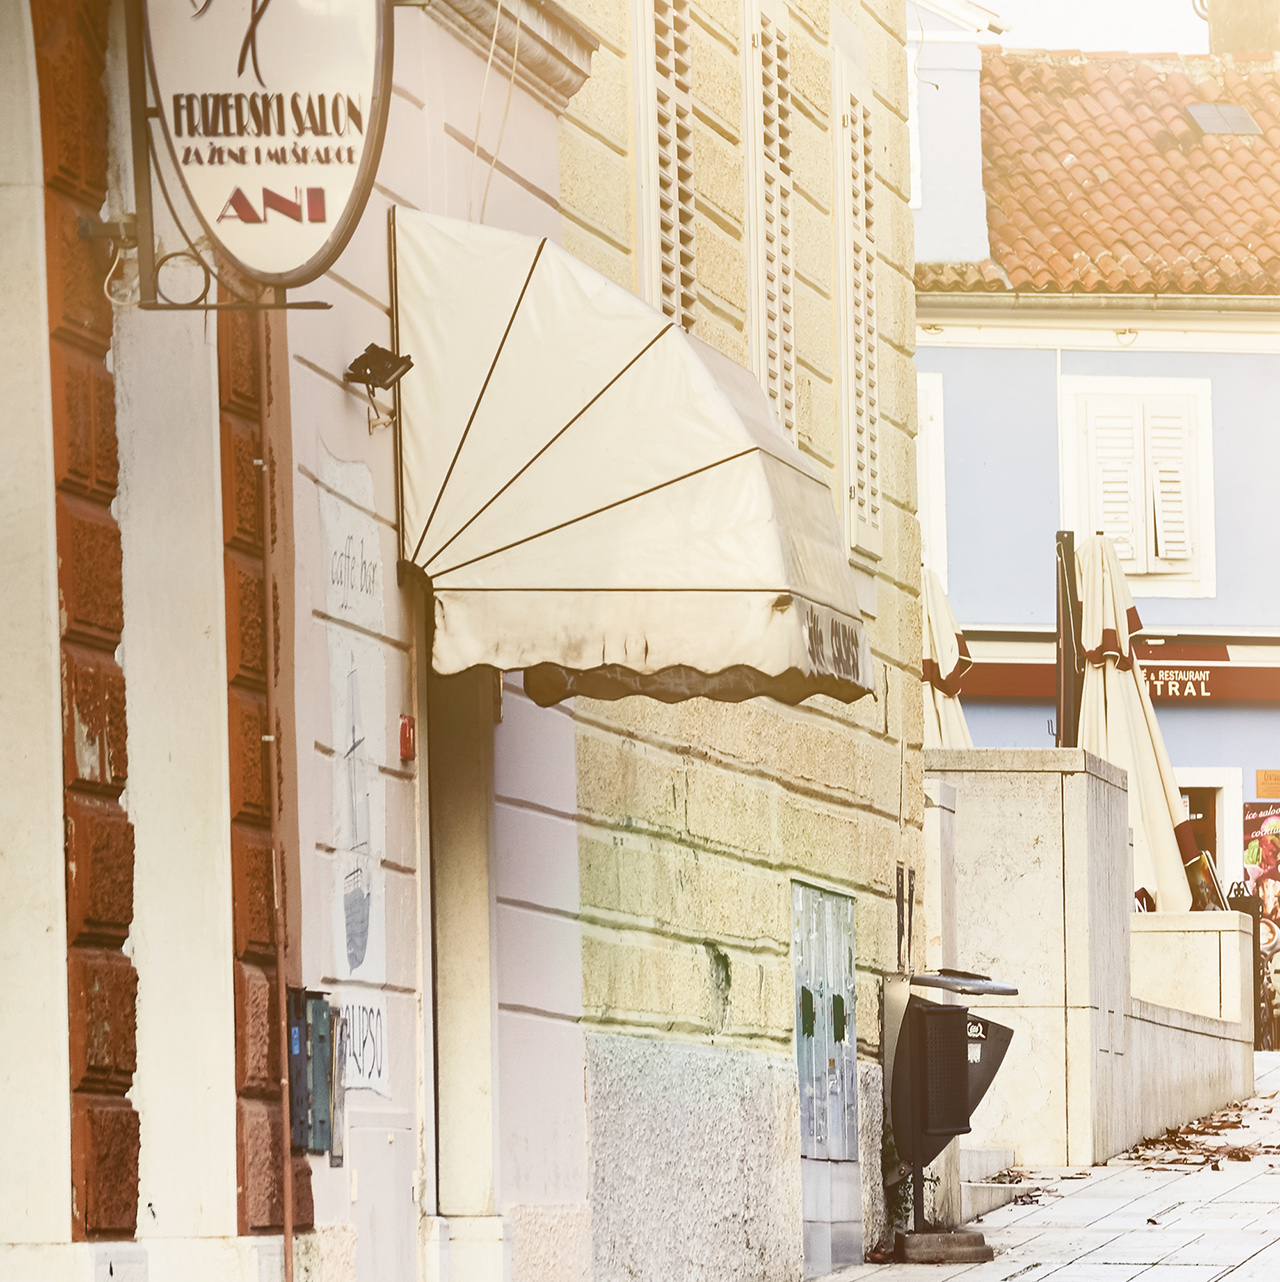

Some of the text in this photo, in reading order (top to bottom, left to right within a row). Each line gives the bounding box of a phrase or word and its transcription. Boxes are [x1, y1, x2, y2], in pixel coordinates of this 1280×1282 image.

[173, 91, 364, 138] FRIZERSKI SALON
[181, 145, 205, 165] ZA
[254, 145, 262, 165] I
[216, 184, 327, 224] ANI
[360, 538, 378, 597] bar
[1158, 670, 1211, 682] RESTAURANT
[1245, 811, 1258, 821] ice
[340, 1004, 383, 1080] ALIPSO
